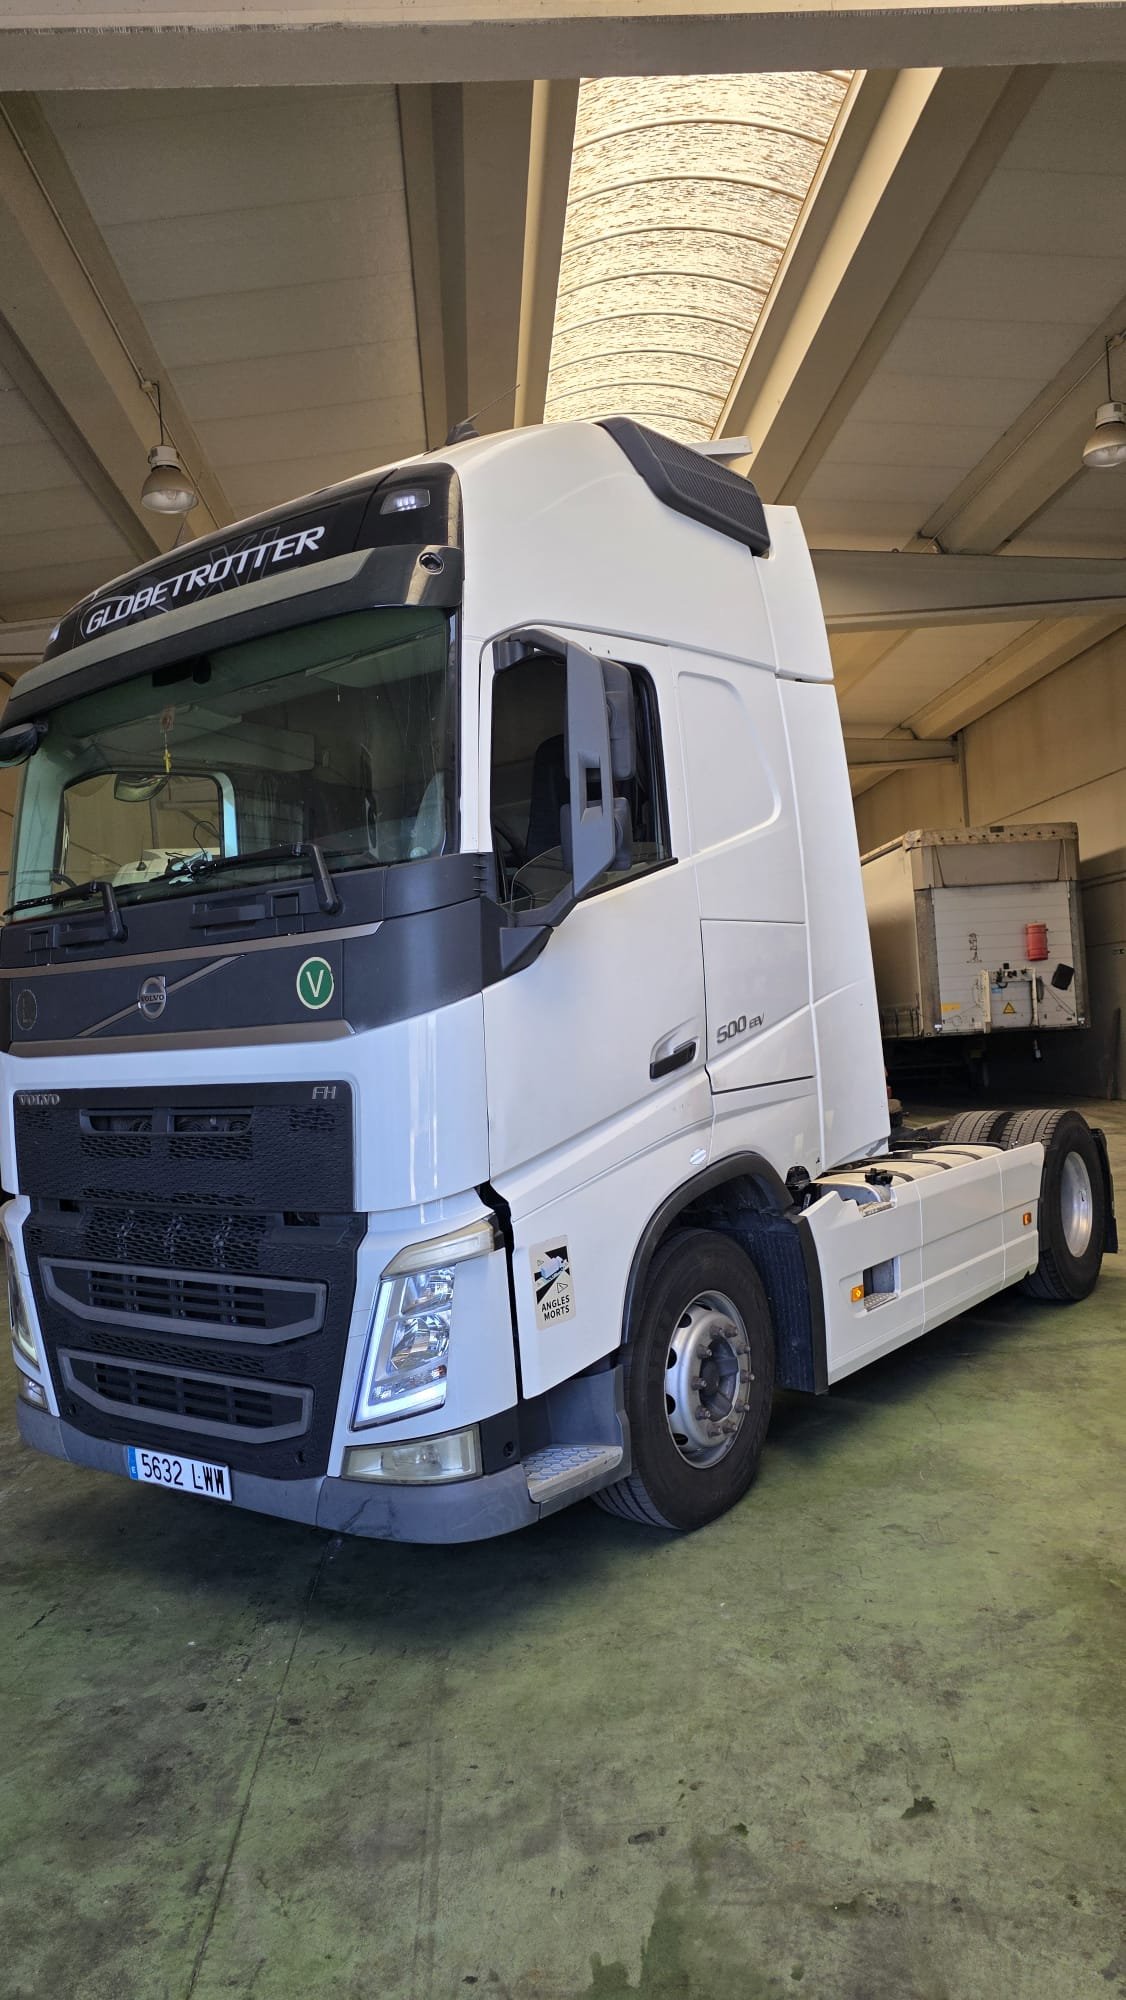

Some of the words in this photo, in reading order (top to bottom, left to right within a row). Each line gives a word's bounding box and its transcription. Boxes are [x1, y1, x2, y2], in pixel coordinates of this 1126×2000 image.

[86, 526, 326, 635] GLOBETROTTER
[306, 970, 324, 998] V
[141, 994, 165, 1002] VOLVO
[717, 1015, 747, 1044] 500
[17, 1094, 60, 1106] VOLVO
[311, 1086, 337, 1100] FH
[541, 1295, 570, 1313] ANGLES
[543, 1305, 570, 1321] MORTS
[141, 1453, 184, 1487] 5632
[191, 1463, 225, 1495] LWW
